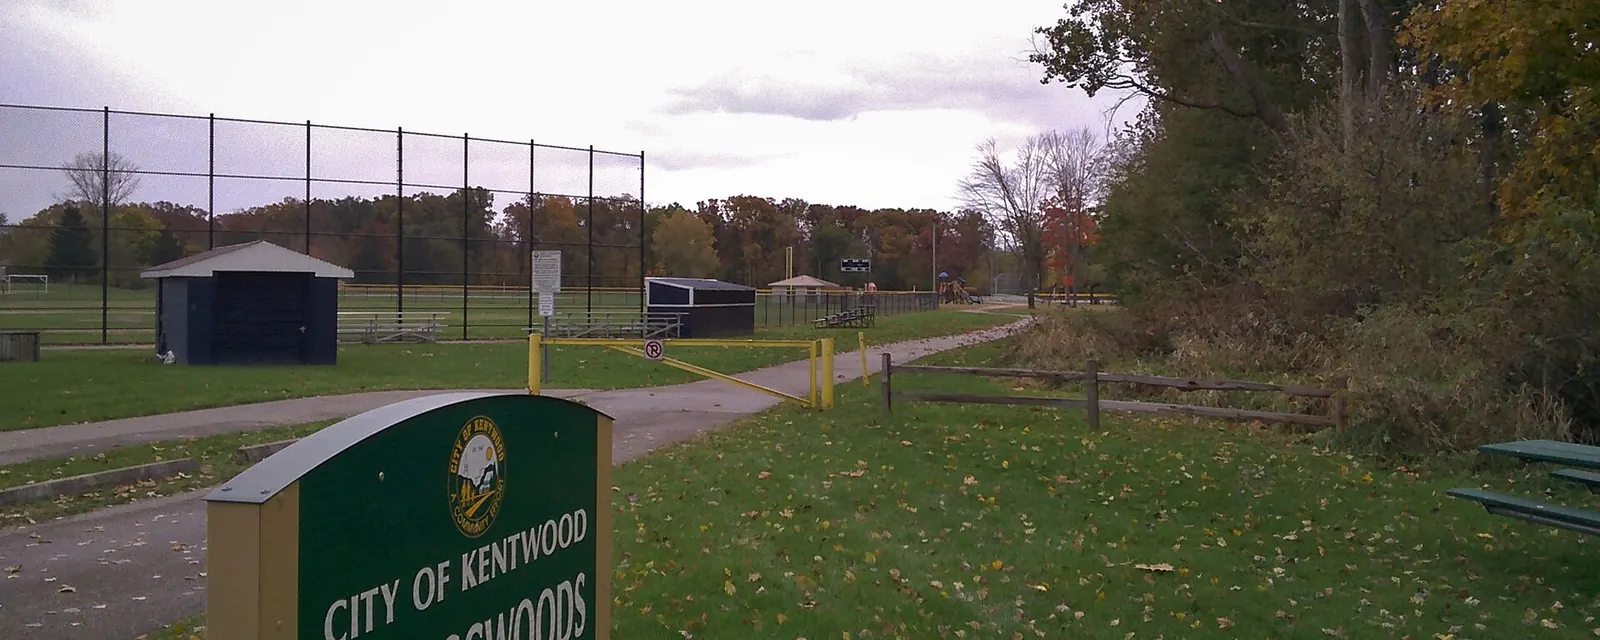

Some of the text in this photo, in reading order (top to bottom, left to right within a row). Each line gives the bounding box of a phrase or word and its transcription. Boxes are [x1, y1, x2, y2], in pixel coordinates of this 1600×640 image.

[450, 419, 504, 474] CITY OF KENTWOOD
[324, 508, 587, 640] CITY OF KENTWOOD
